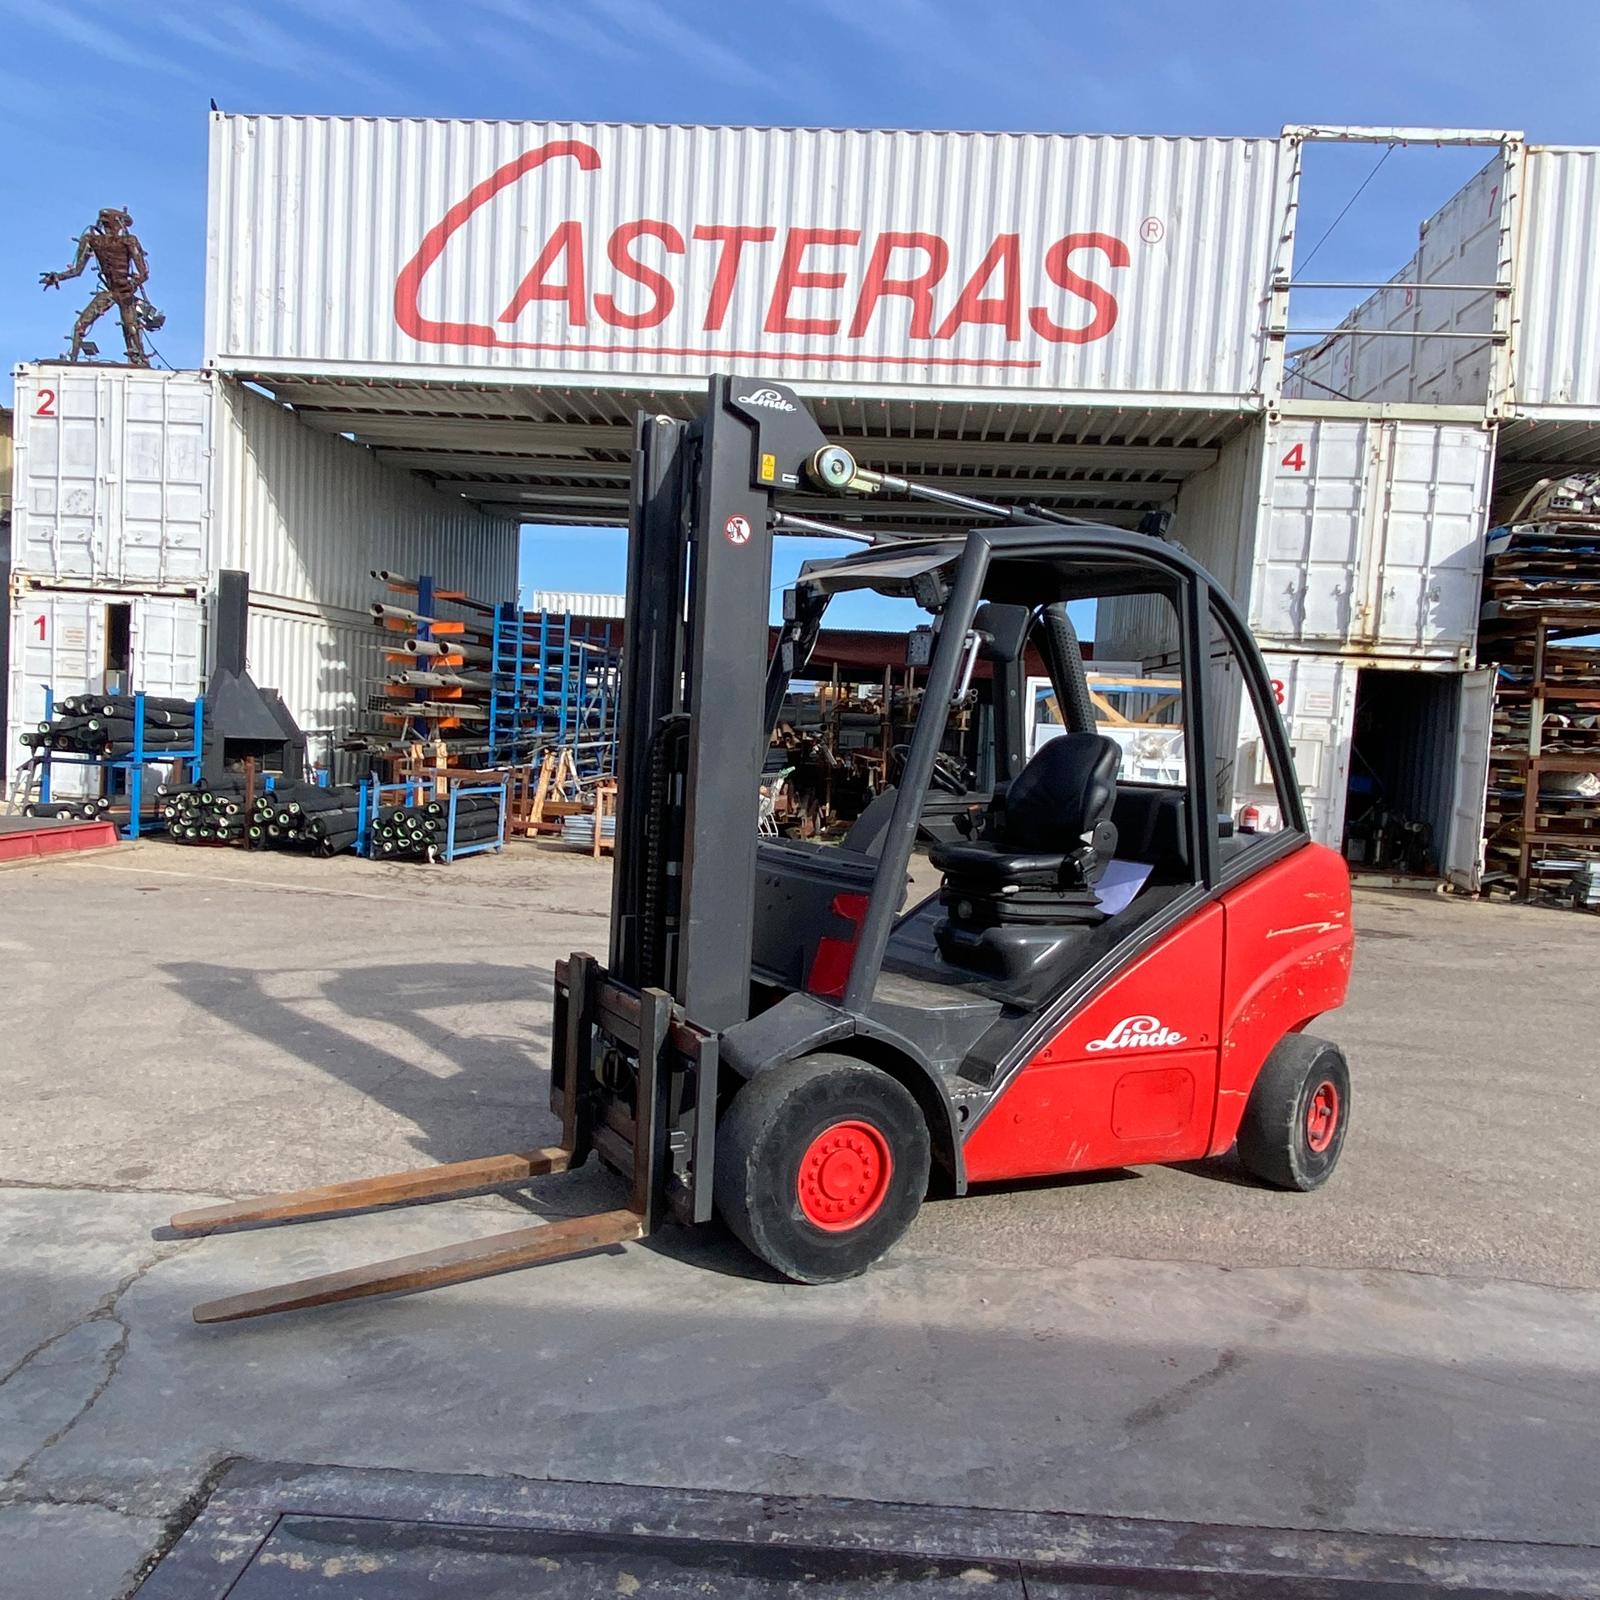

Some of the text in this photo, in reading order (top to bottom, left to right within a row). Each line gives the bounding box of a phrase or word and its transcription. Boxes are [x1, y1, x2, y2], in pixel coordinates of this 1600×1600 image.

[394, 139, 1131, 347] CASTERAS
[36, 389, 55, 416] 2
[737, 388, 797, 412] Linde
[1281, 443, 1306, 472] 4
[33, 614, 46, 641] 1
[1085, 1014, 1188, 1052] Linde
